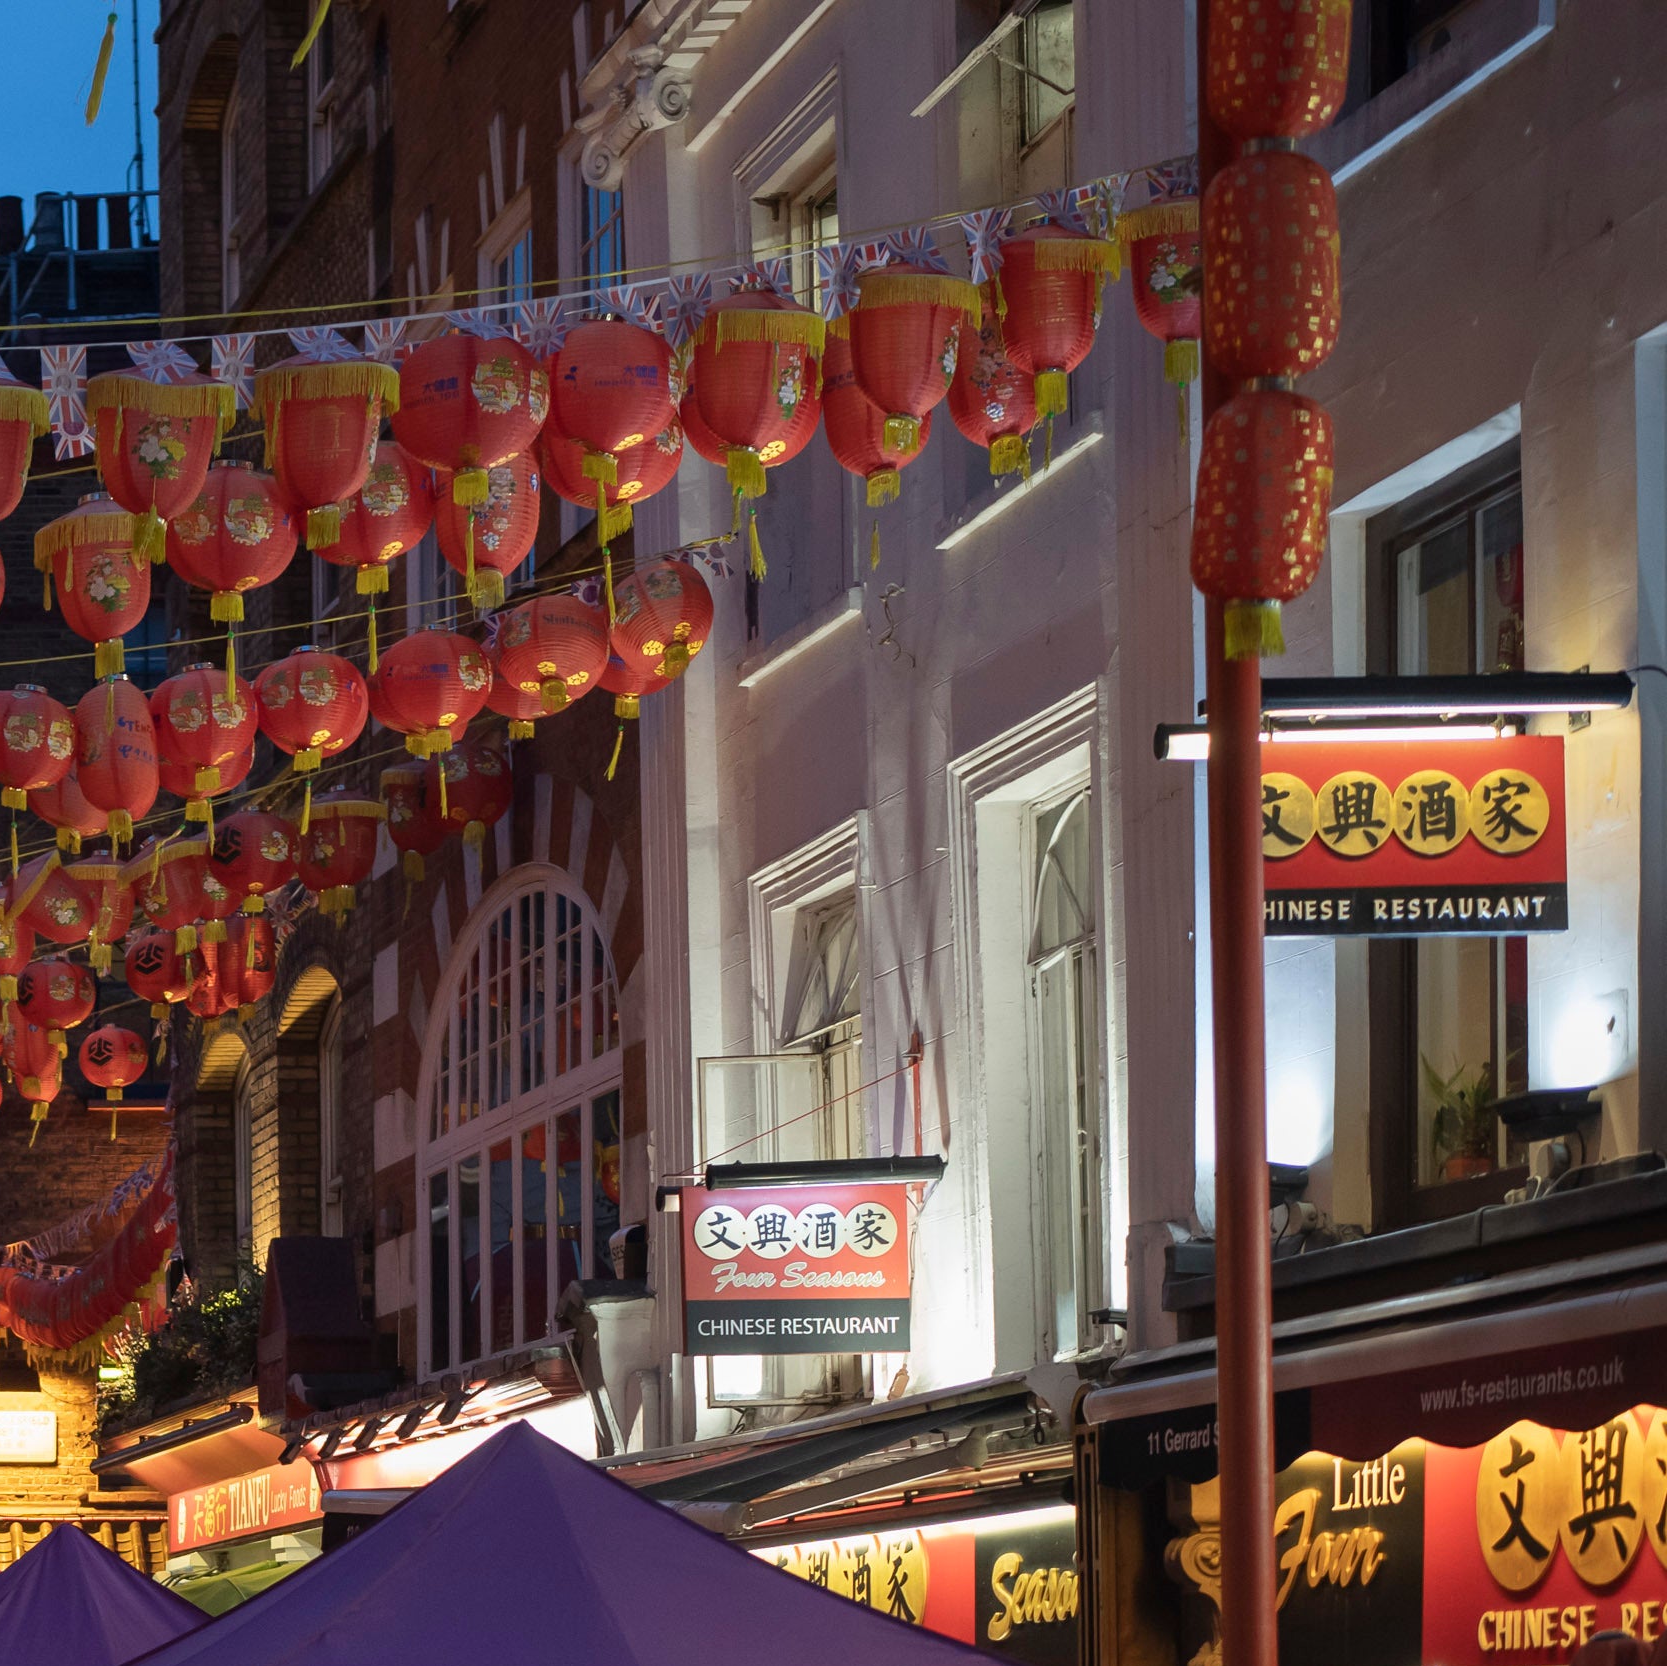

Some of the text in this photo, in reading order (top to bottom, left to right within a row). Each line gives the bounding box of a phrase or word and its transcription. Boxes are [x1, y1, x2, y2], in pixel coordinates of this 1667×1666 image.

[1263, 896, 1546, 921] HINESE RESTAURANT
[711, 1261, 886, 1292] Four Seasons
[698, 1317, 900, 1336] CHINESE RESTAURANT
[1420, 1355, 1625, 1414] www.fs-restaurants.co.uk
[1147, 1431, 1160, 1456] 11
[1165, 1426, 1211, 1454] Gerrard
[229, 1474, 306, 1532] TIANFU Lucky Foods
[1331, 1456, 1406, 1512] Little
[1493, 1420, 1667, 1563] 文興
[1275, 1488, 1385, 1611] Four
[1478, 1605, 1596, 1652] CHINESE
